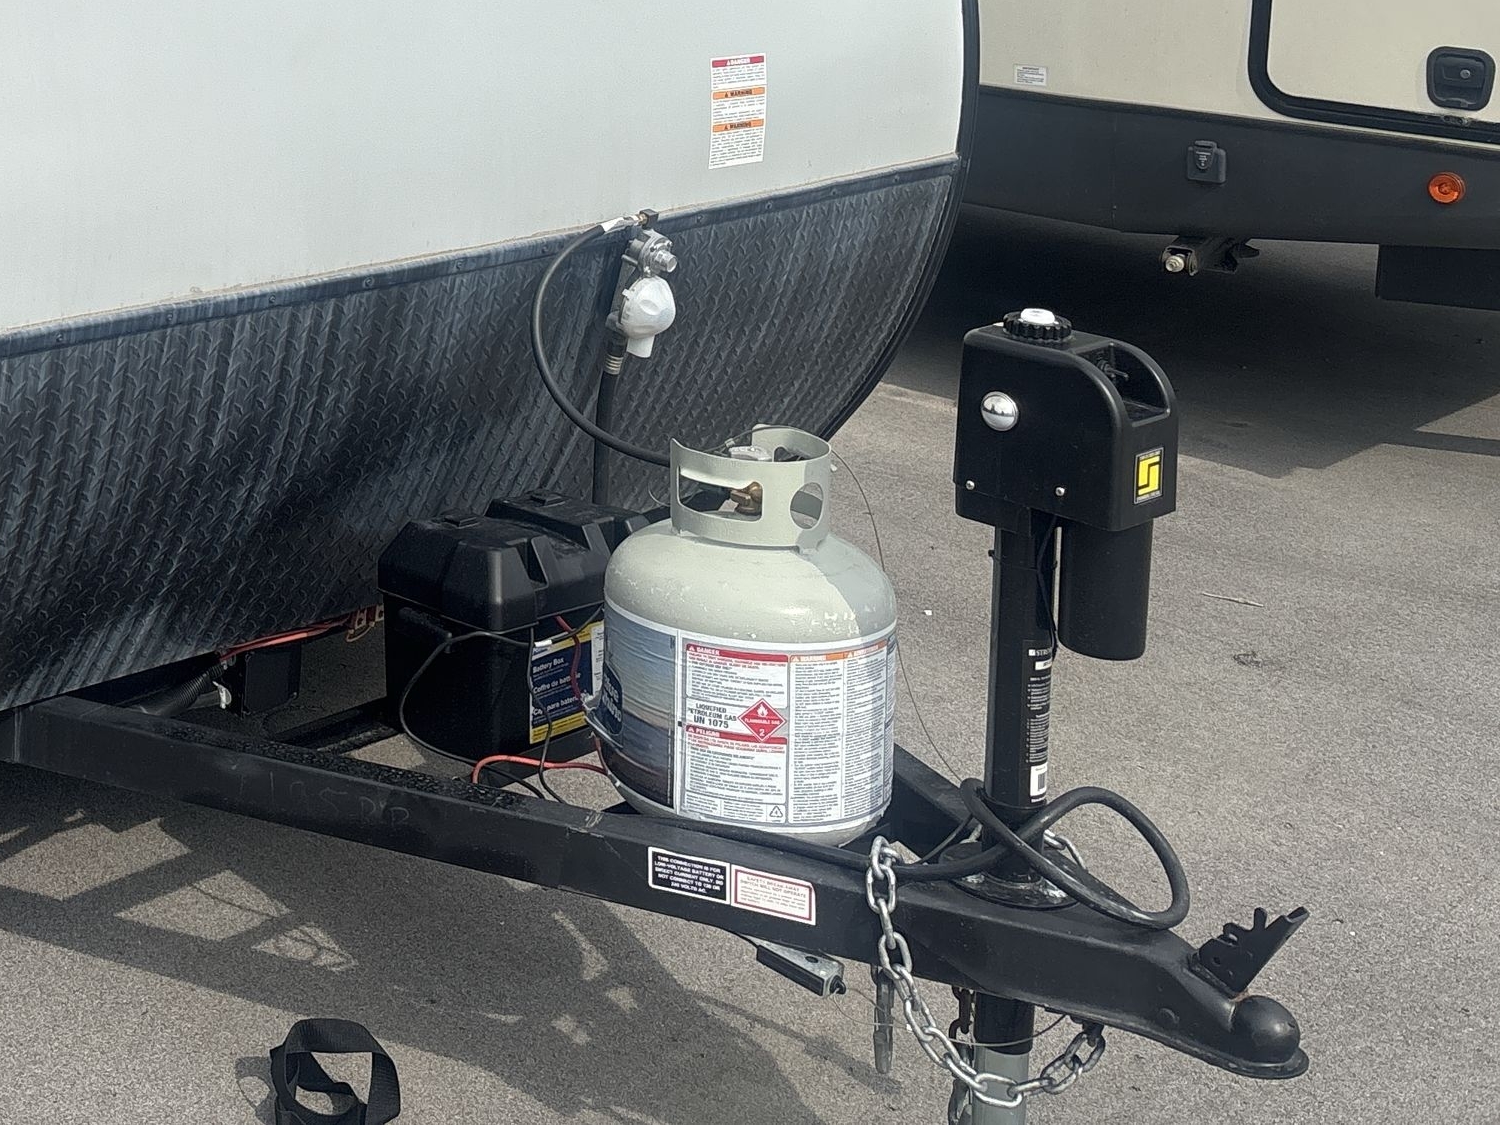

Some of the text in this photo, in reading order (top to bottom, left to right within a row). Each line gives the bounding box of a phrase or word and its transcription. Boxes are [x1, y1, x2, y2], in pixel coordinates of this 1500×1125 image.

[696, 647, 720, 655] DANGER
[532, 662, 553, 674] Battery
[553, 657, 565, 665] Box
[695, 703, 727, 713] LIQUEFIED
[693, 715, 729, 728] UN 1075
[695, 727, 720, 737] PELIGRO
[670, 858, 703, 870] CONNECTION
[674, 870, 699, 880] CURRENT
[691, 868, 715, 878] BATTERY
[669, 875, 694, 885] CONNECT
[680, 883, 698, 891] VOLTS
[783, 889, 807, 898] OPERATE
